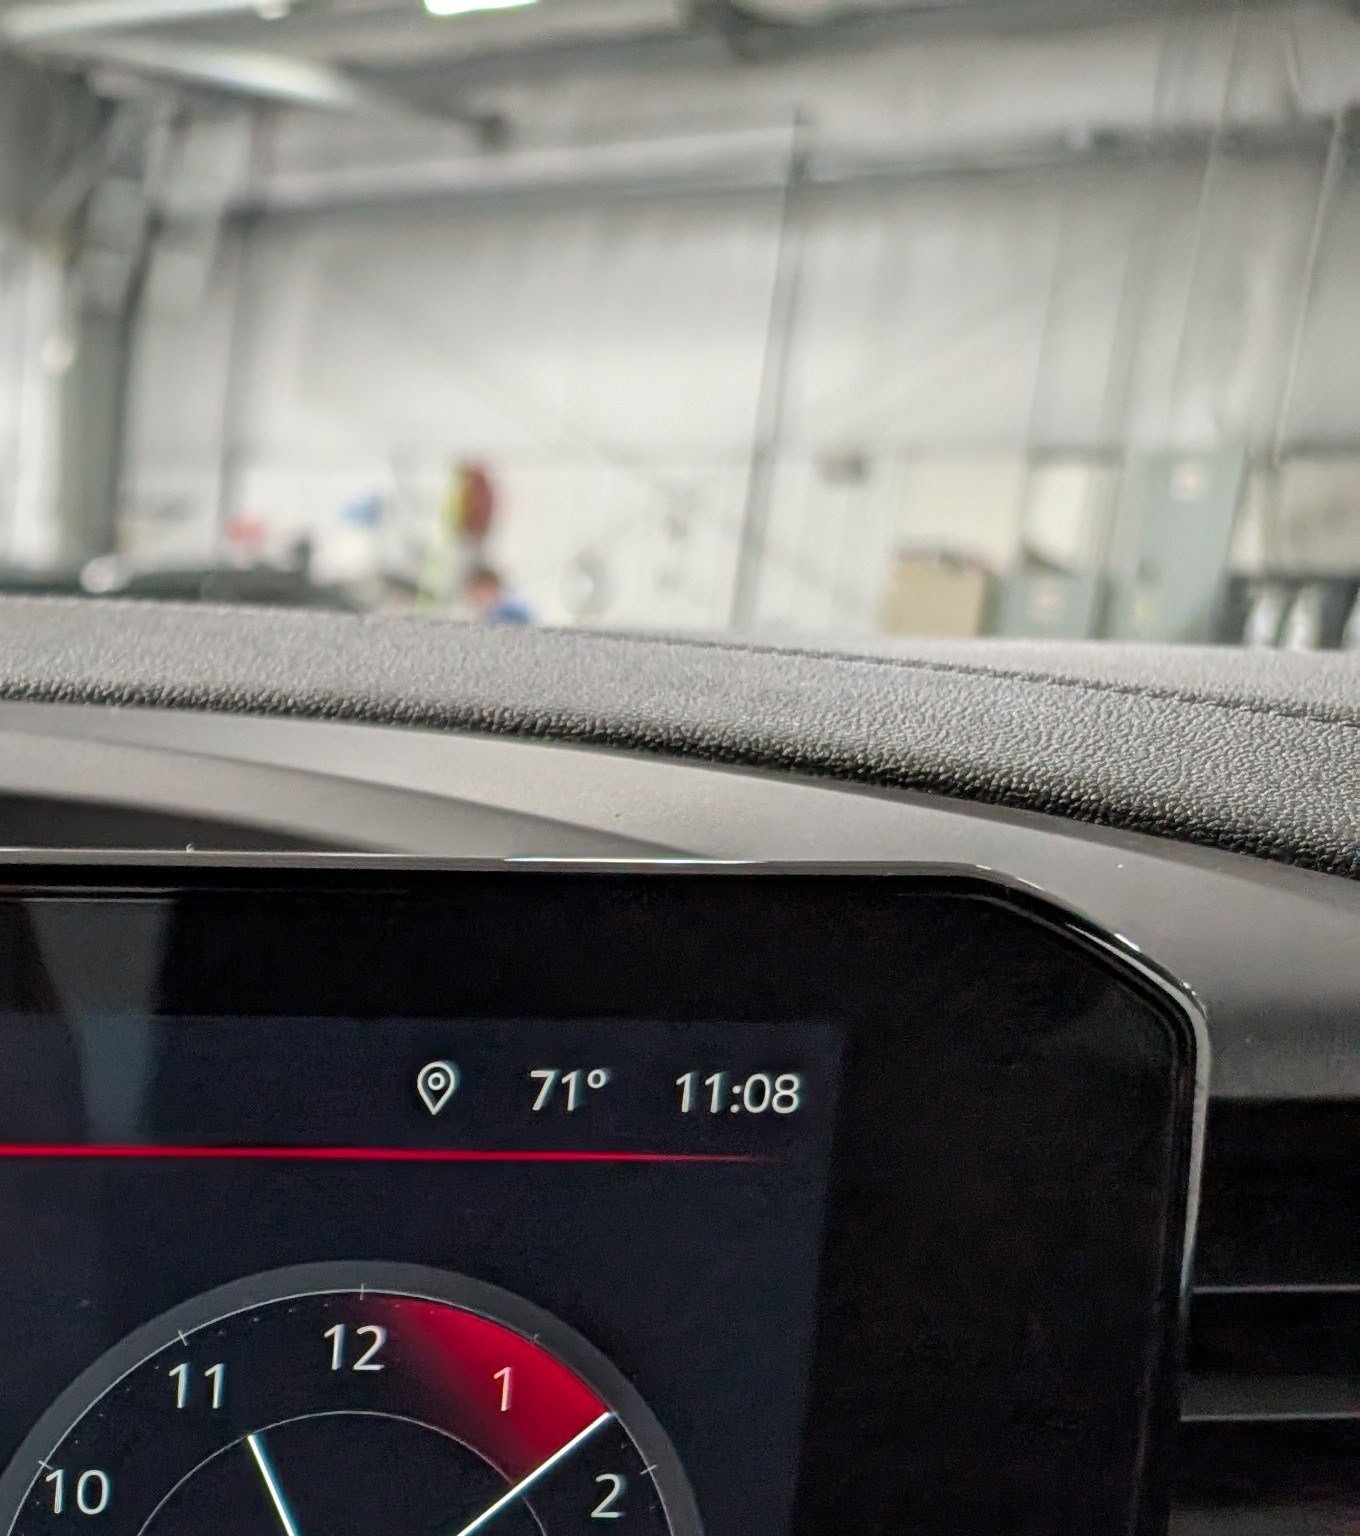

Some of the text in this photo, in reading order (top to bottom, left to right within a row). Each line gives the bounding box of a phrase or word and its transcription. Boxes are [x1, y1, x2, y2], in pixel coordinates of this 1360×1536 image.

[676, 1072, 800, 1114] 11:08
[324, 1324, 385, 1371] 12
[168, 1363, 224, 1409] 11
[493, 1366, 511, 1412] 1
[45, 1469, 109, 1515] 10
[590, 1473, 622, 1519] 2
